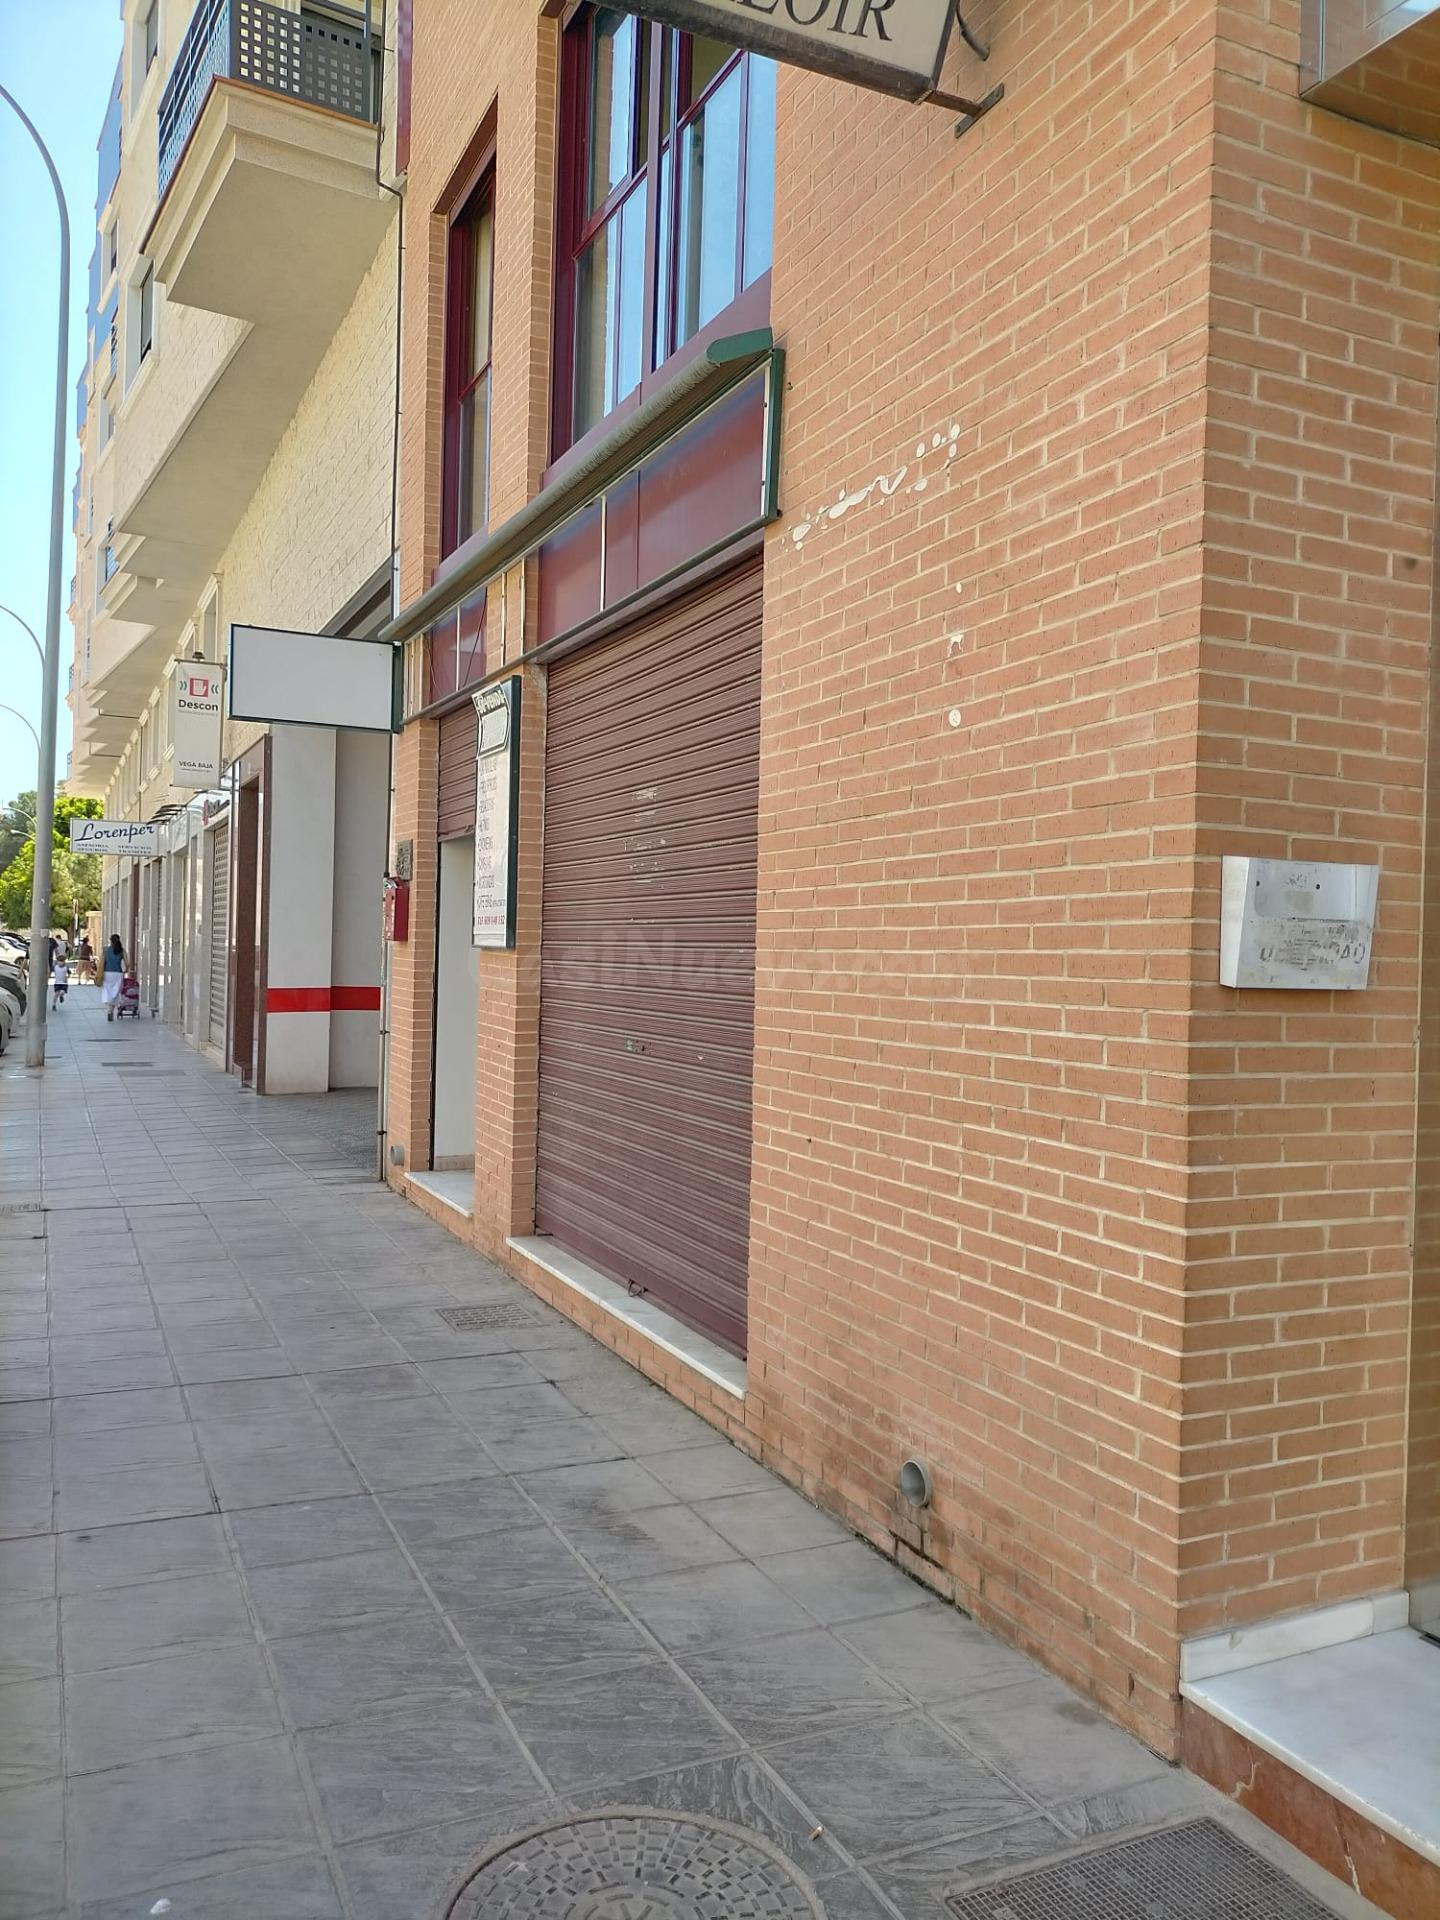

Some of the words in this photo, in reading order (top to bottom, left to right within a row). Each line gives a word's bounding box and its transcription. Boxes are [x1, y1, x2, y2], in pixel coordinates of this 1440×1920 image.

[178, 699, 219, 711] Descon
[178, 760, 197, 768] VEGA
[74, 823, 155, 843] Lorenper
